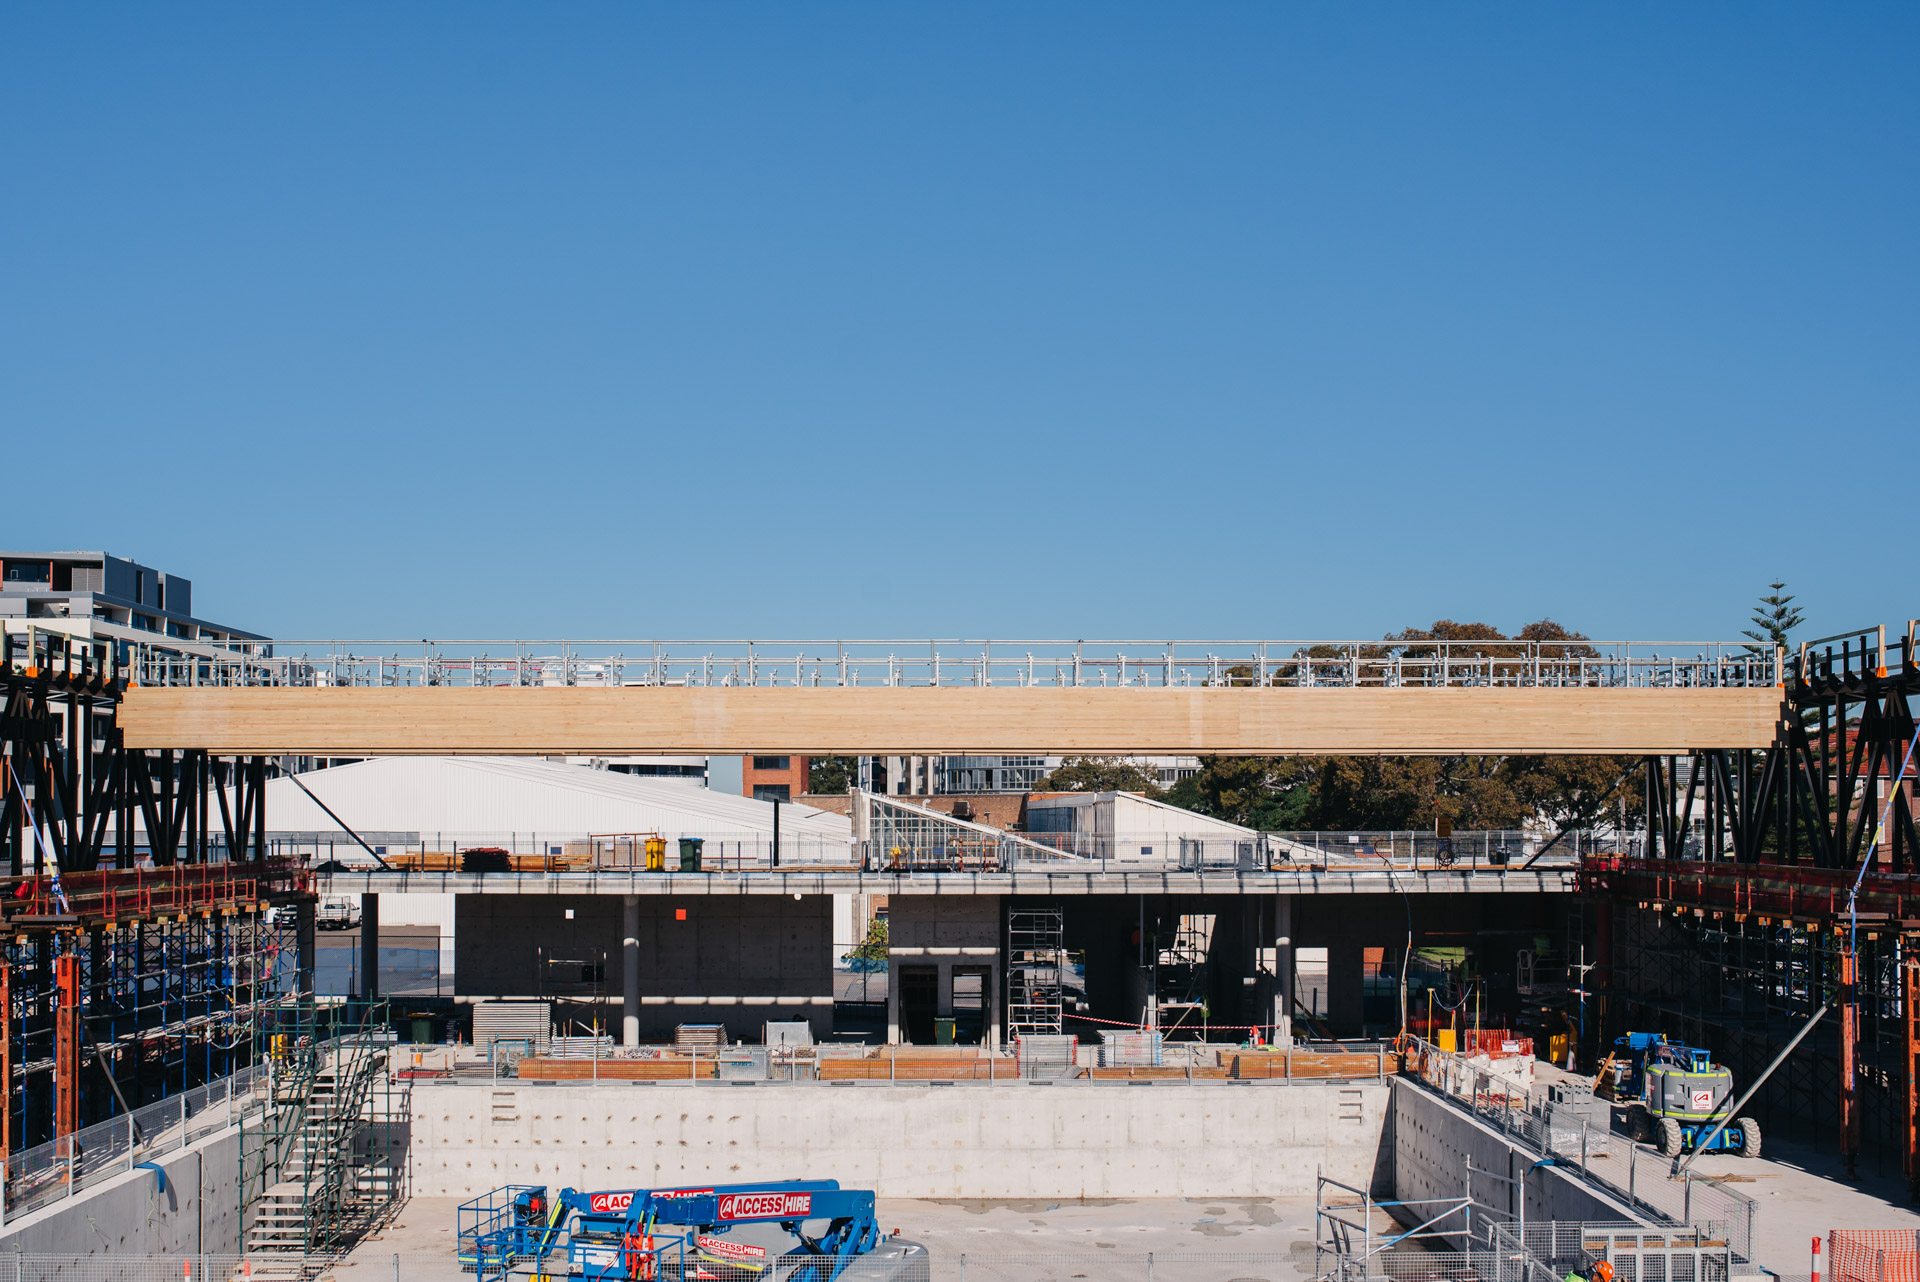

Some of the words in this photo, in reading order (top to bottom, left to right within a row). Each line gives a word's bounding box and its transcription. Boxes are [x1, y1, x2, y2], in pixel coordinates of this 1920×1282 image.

[735, 1197, 782, 1215] ACCESS
[784, 1196, 811, 1213] HIRE
[708, 1240, 742, 1252] ACCESS
[743, 1246, 765, 1256] HIRE
